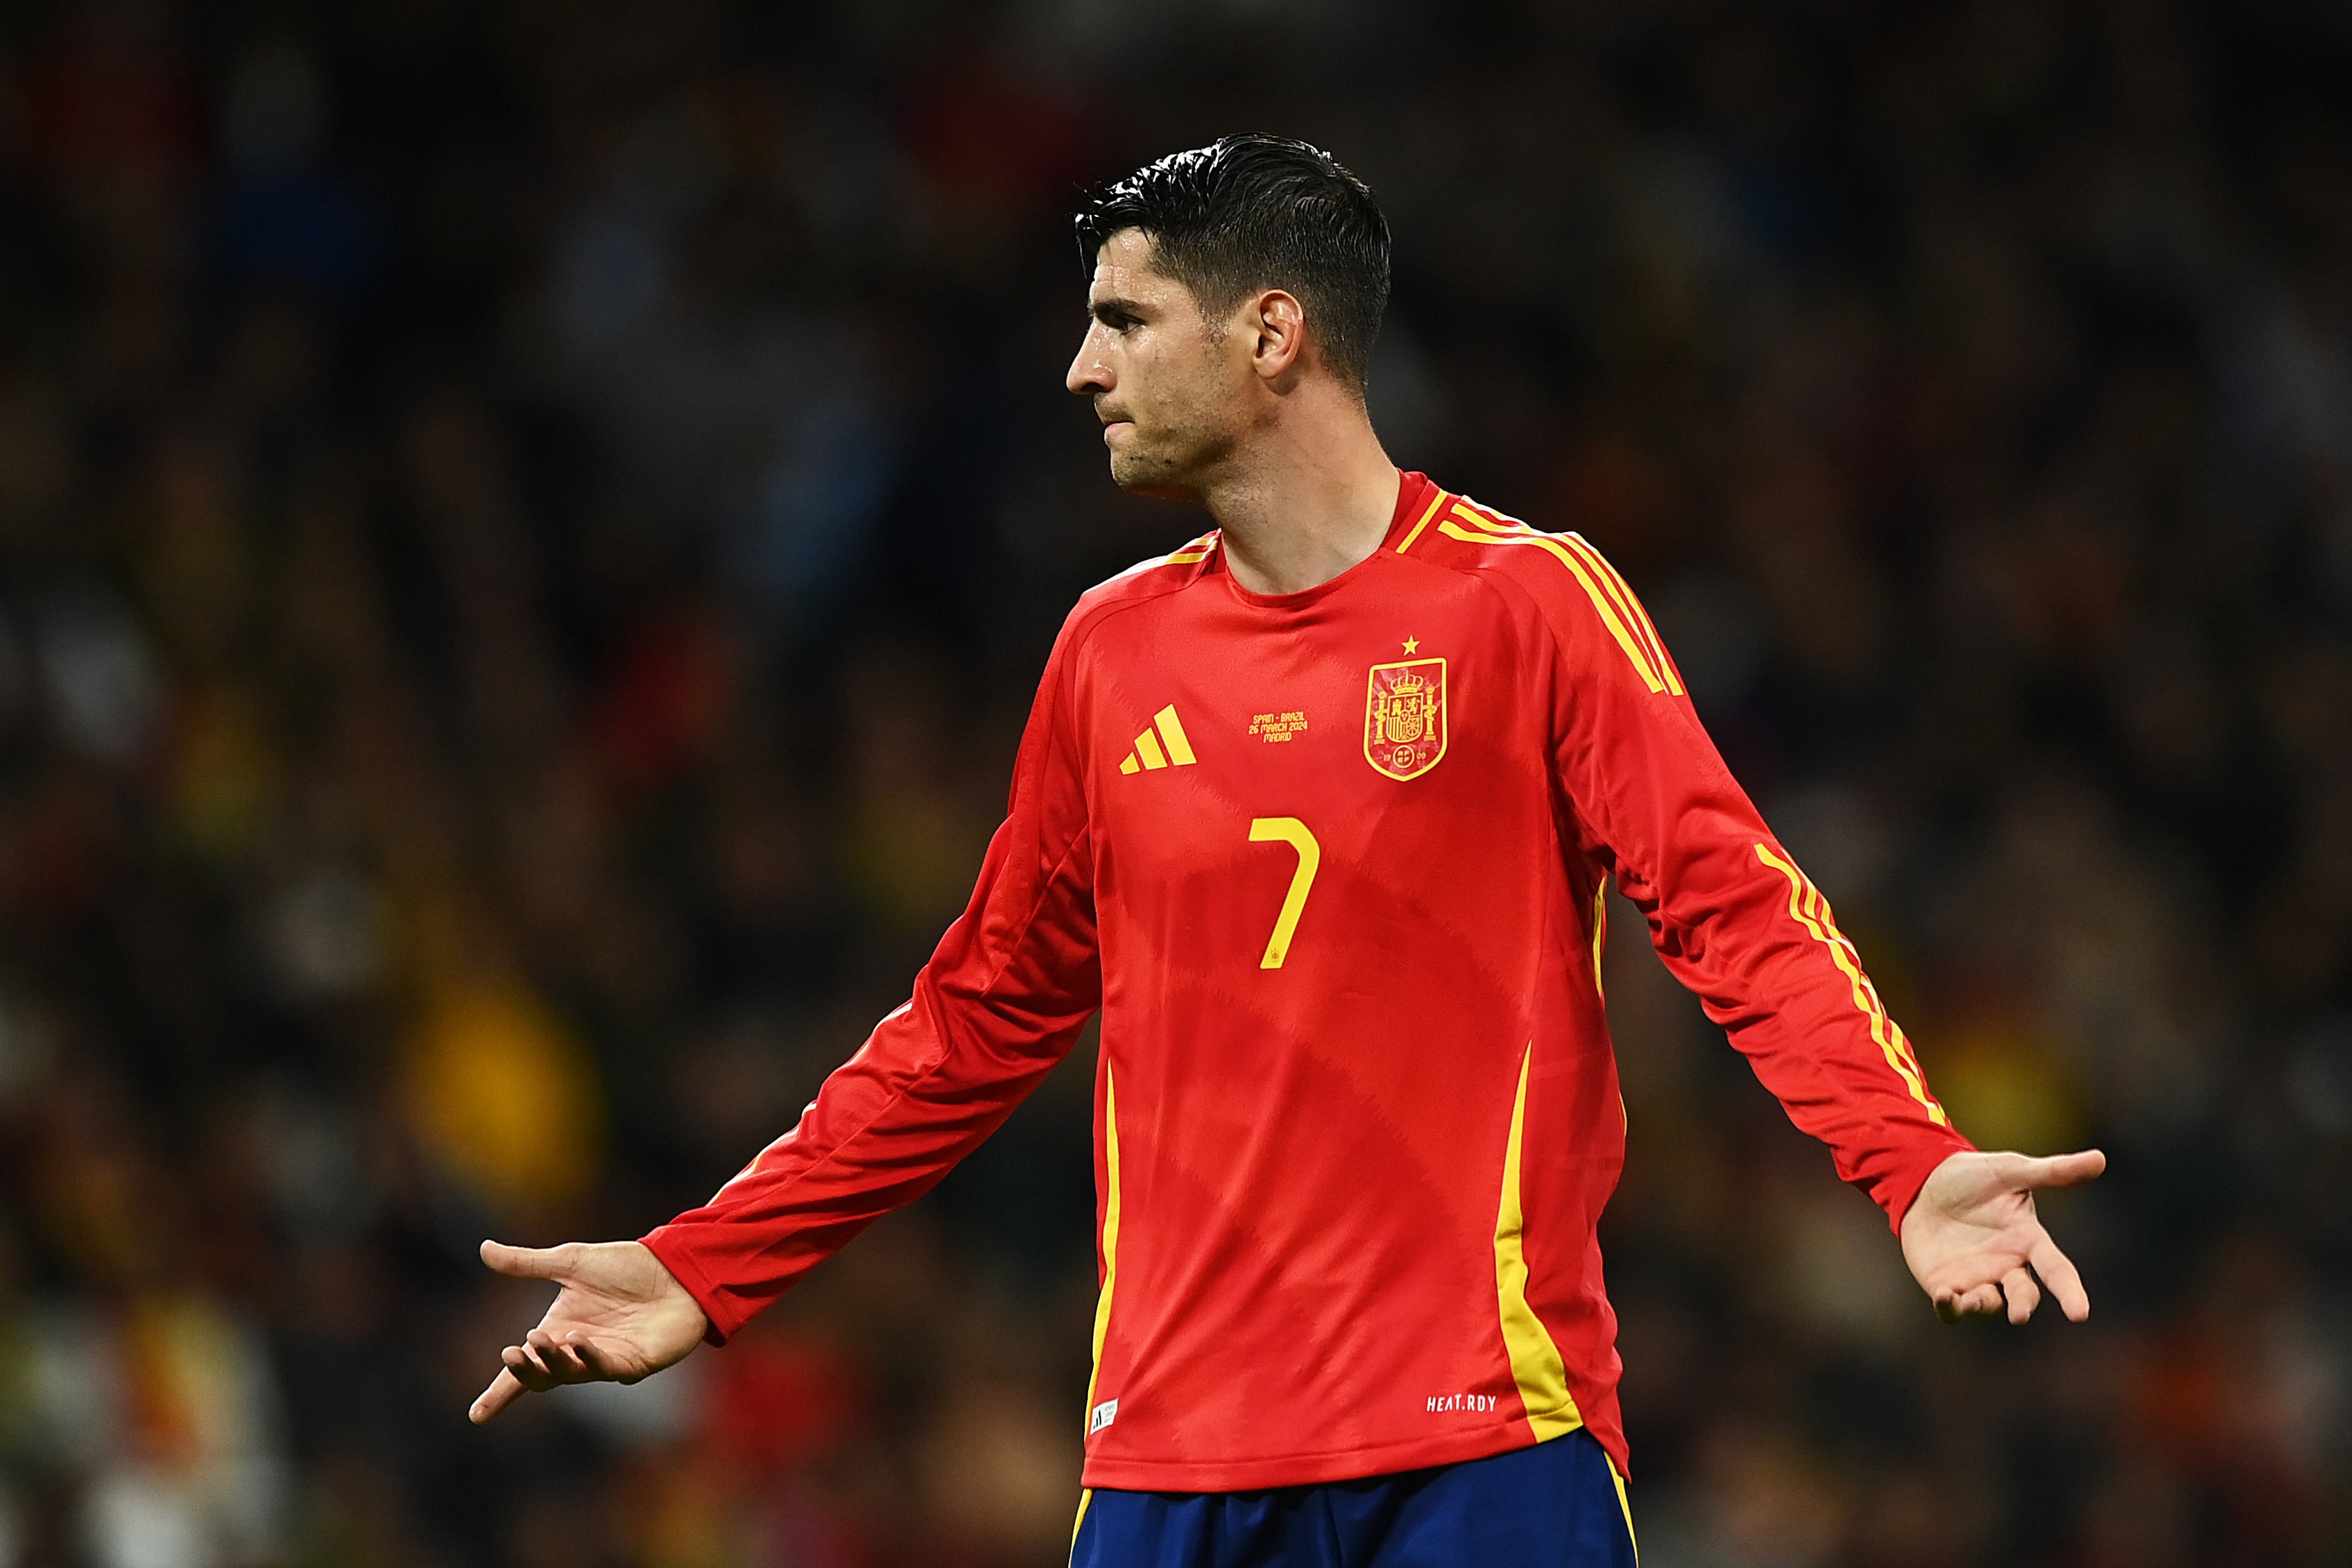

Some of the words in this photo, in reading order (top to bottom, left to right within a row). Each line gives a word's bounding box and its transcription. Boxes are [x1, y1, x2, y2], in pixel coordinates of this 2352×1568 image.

[1253, 714, 1274, 724] SPAIN
[1280, 712, 1305, 723] BRAZIL
[1248, 724, 1259, 734] 26
[1261, 723, 1287, 734] MARCH
[1289, 721, 1307, 731] 2024
[1263, 732, 1291, 743] MADRID
[1248, 817, 1320, 969] 7
[1426, 1393, 1496, 1412] HEAT.RDY
